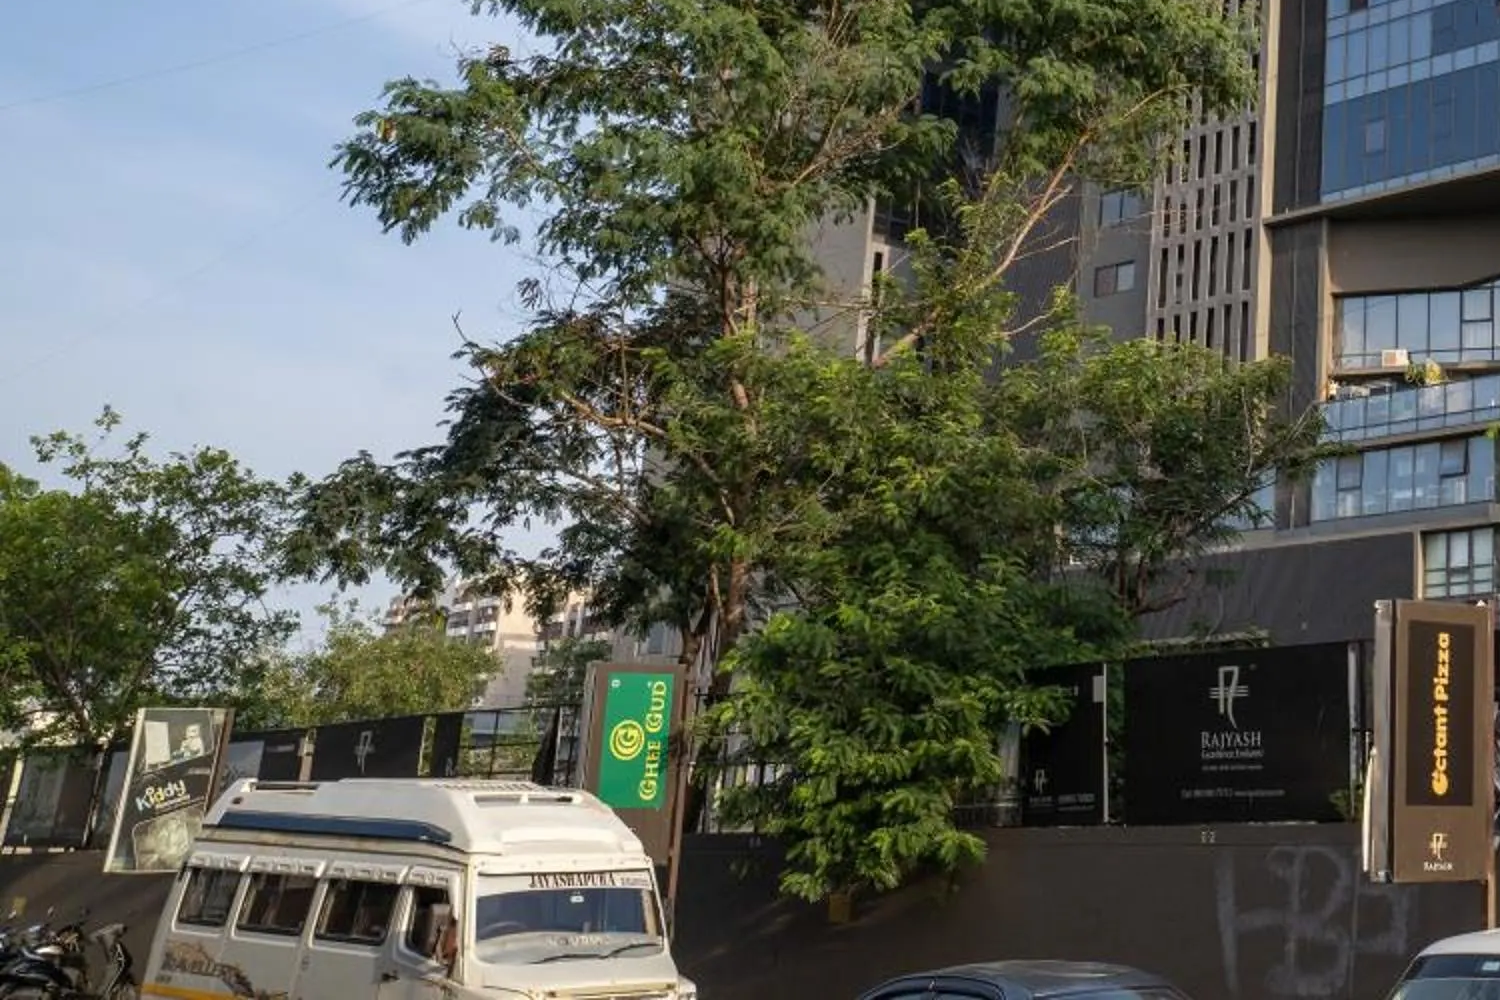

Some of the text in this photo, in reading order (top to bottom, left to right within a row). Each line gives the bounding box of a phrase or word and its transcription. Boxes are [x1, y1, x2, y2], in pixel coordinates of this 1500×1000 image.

[1433, 632, 1450, 701] Pizza
[645, 681, 667, 733] GUD
[1201, 731, 1261, 749] RAJYASH
[136, 780, 187, 812] Kiddy
